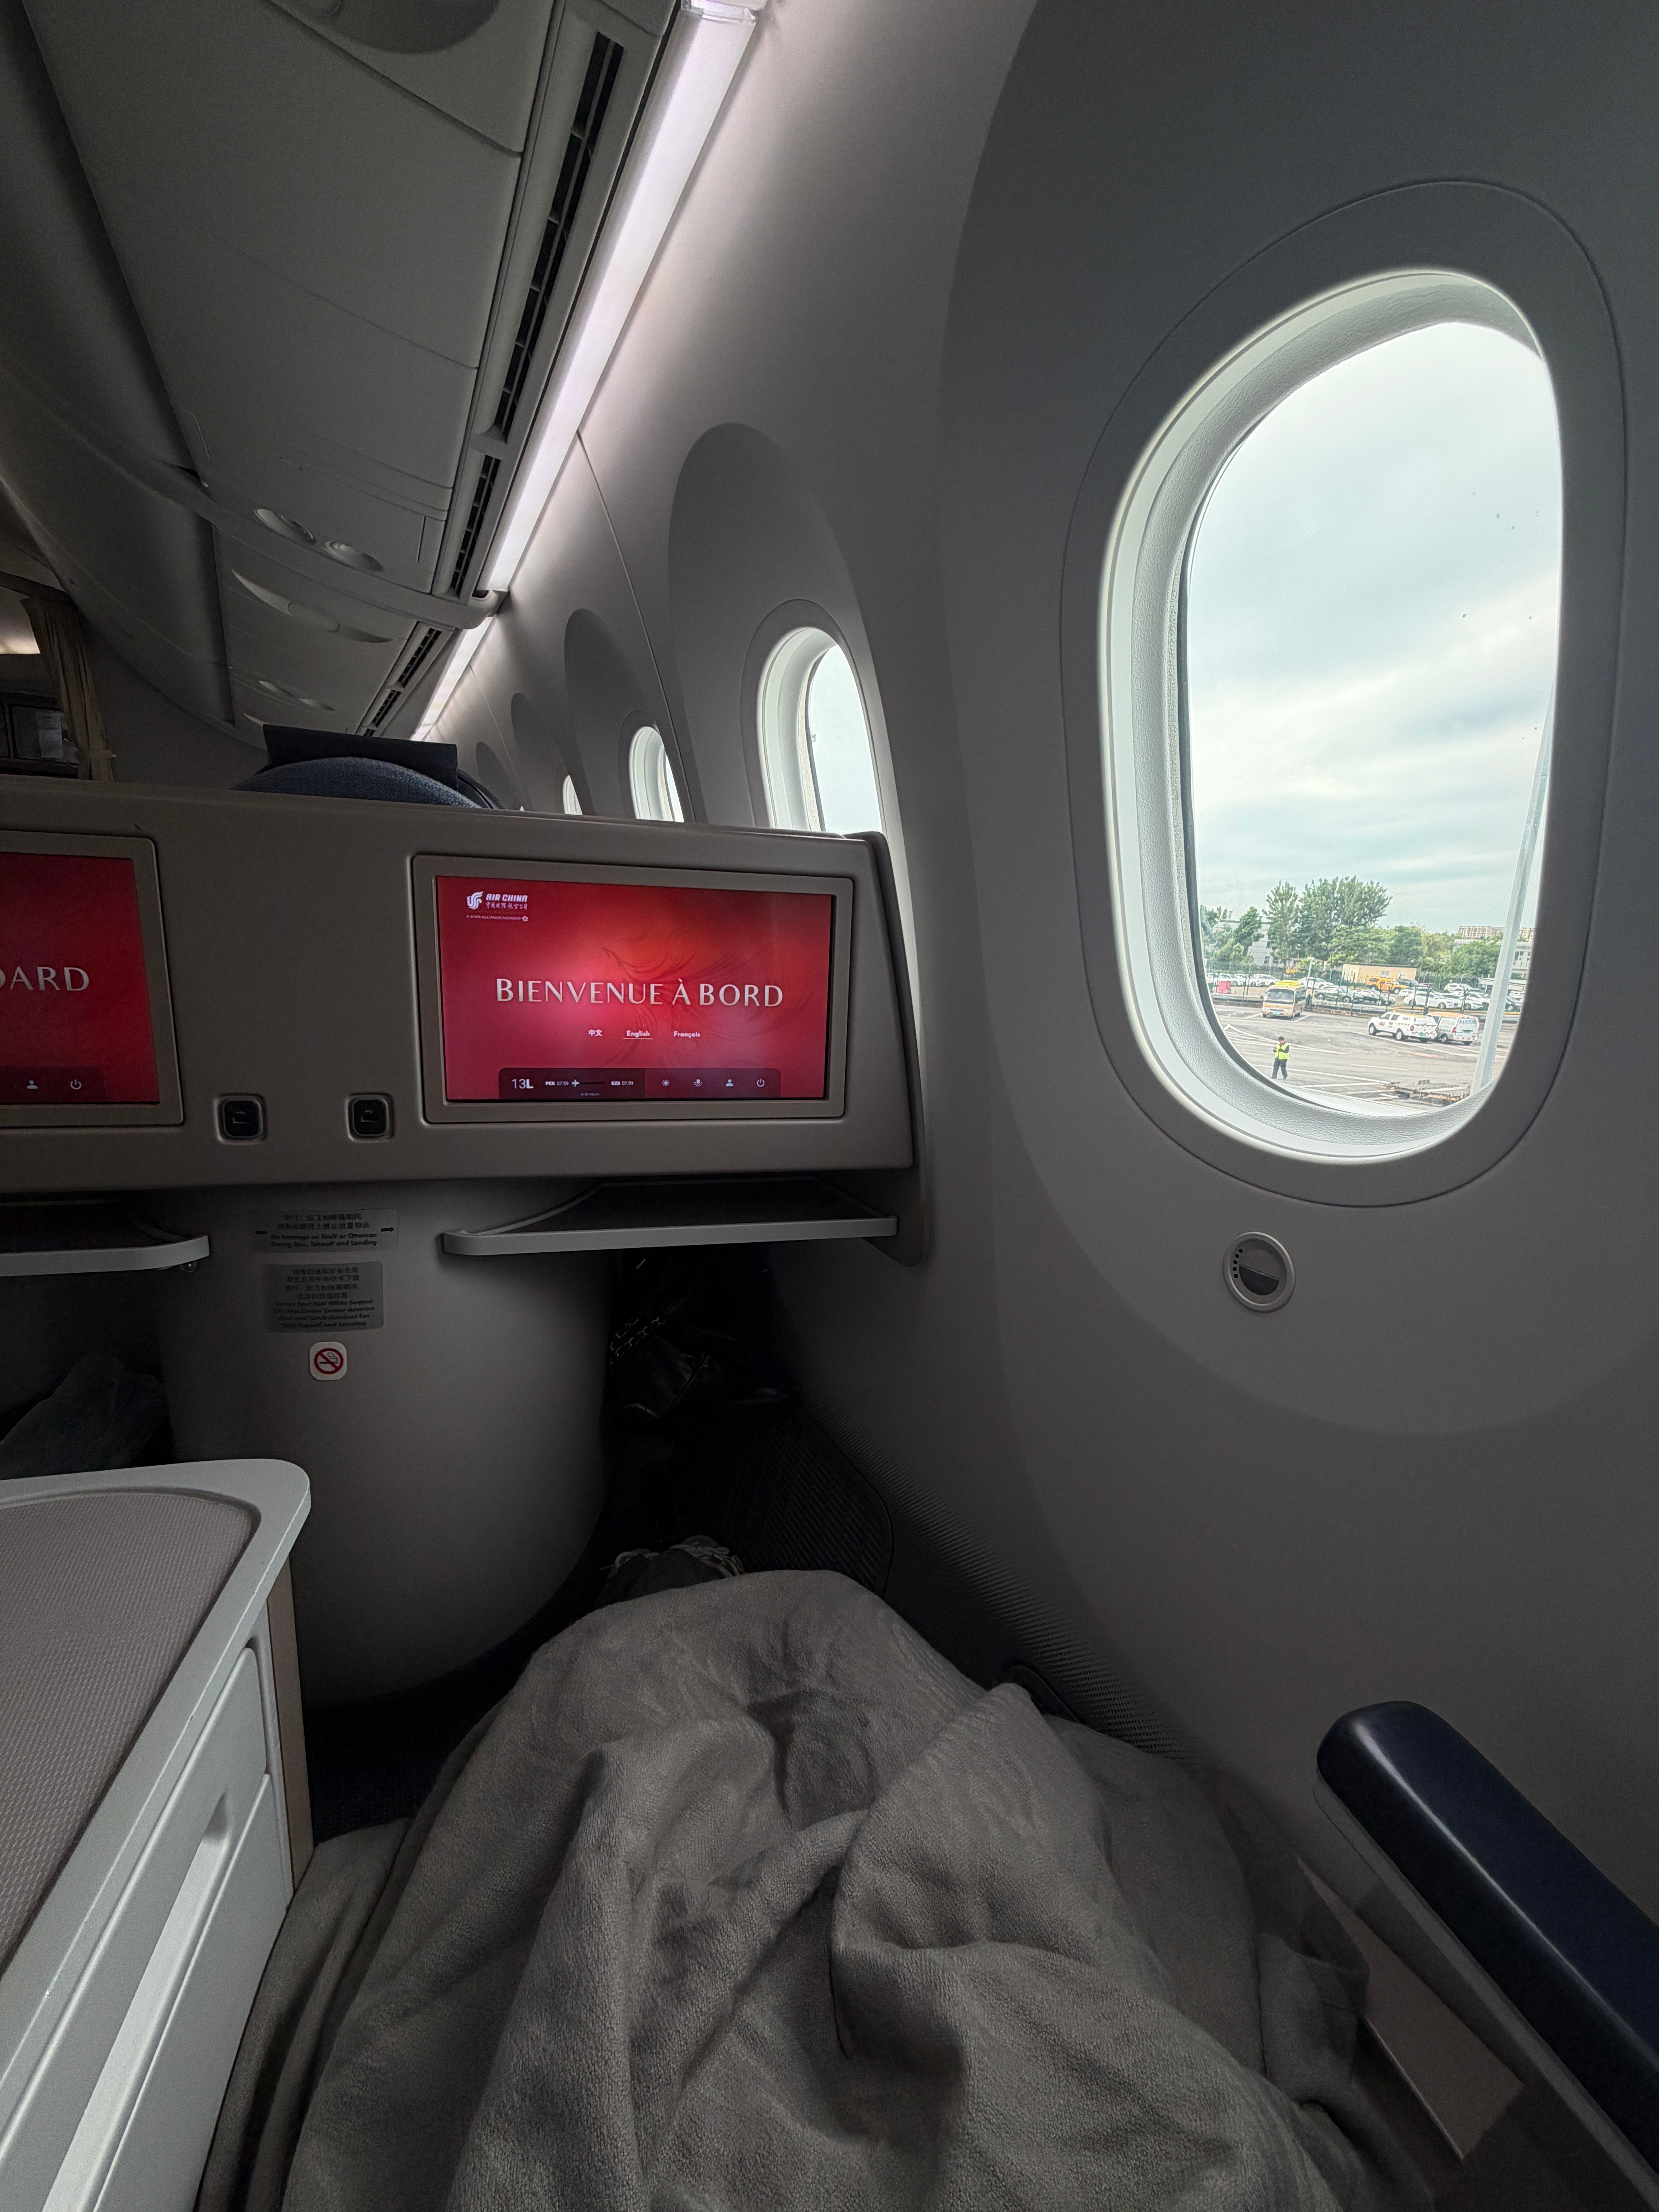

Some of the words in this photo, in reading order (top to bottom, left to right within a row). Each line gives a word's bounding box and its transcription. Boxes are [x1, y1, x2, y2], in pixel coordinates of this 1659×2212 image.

[502, 894, 528, 902] CHINA
[0, 966, 89, 991] ARD
[496, 978, 663, 1006] BIENVENUE
[672, 978, 691, 1006] À
[699, 983, 784, 1007] BORD
[511, 1079, 534, 1089] 13L
